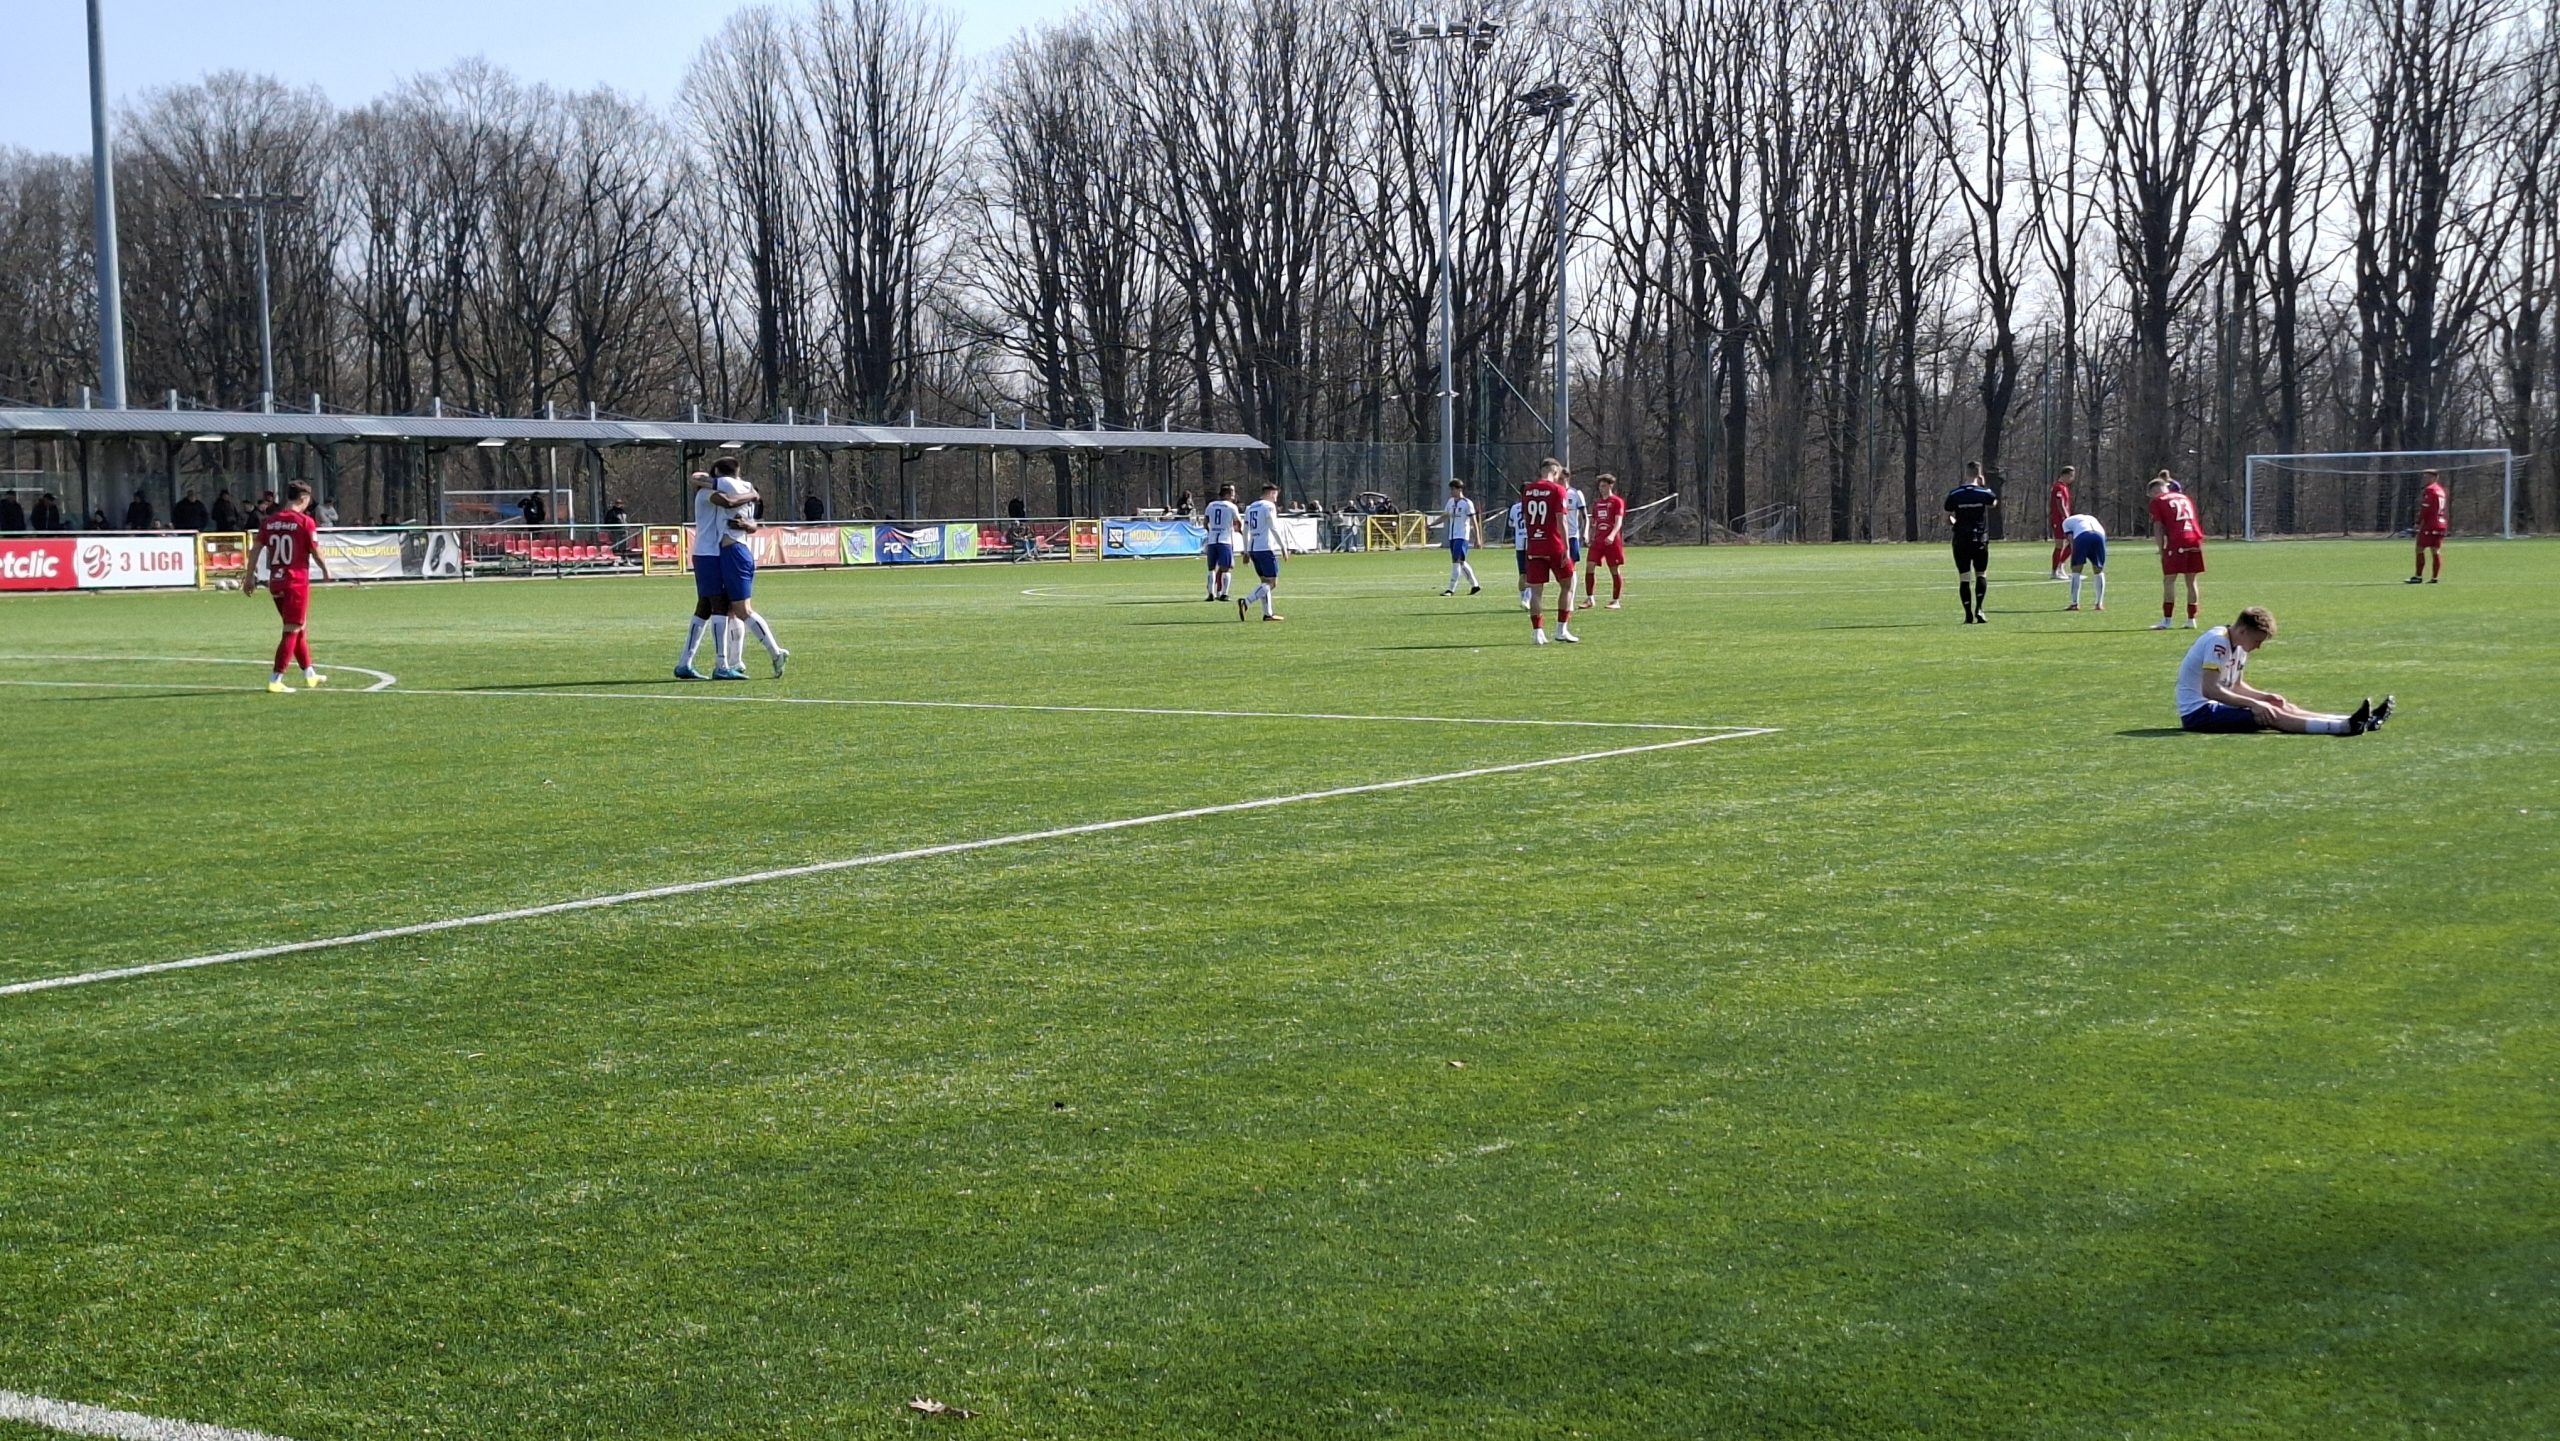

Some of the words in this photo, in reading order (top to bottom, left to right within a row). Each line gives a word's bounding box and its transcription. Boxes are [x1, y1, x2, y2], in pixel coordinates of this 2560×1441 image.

[1527, 500, 1548, 525] 99
[269, 533, 293, 565] 20
[810, 532, 820, 546] DO
[120, 552, 131, 572] 3
[139, 551, 184, 572] LIGA
